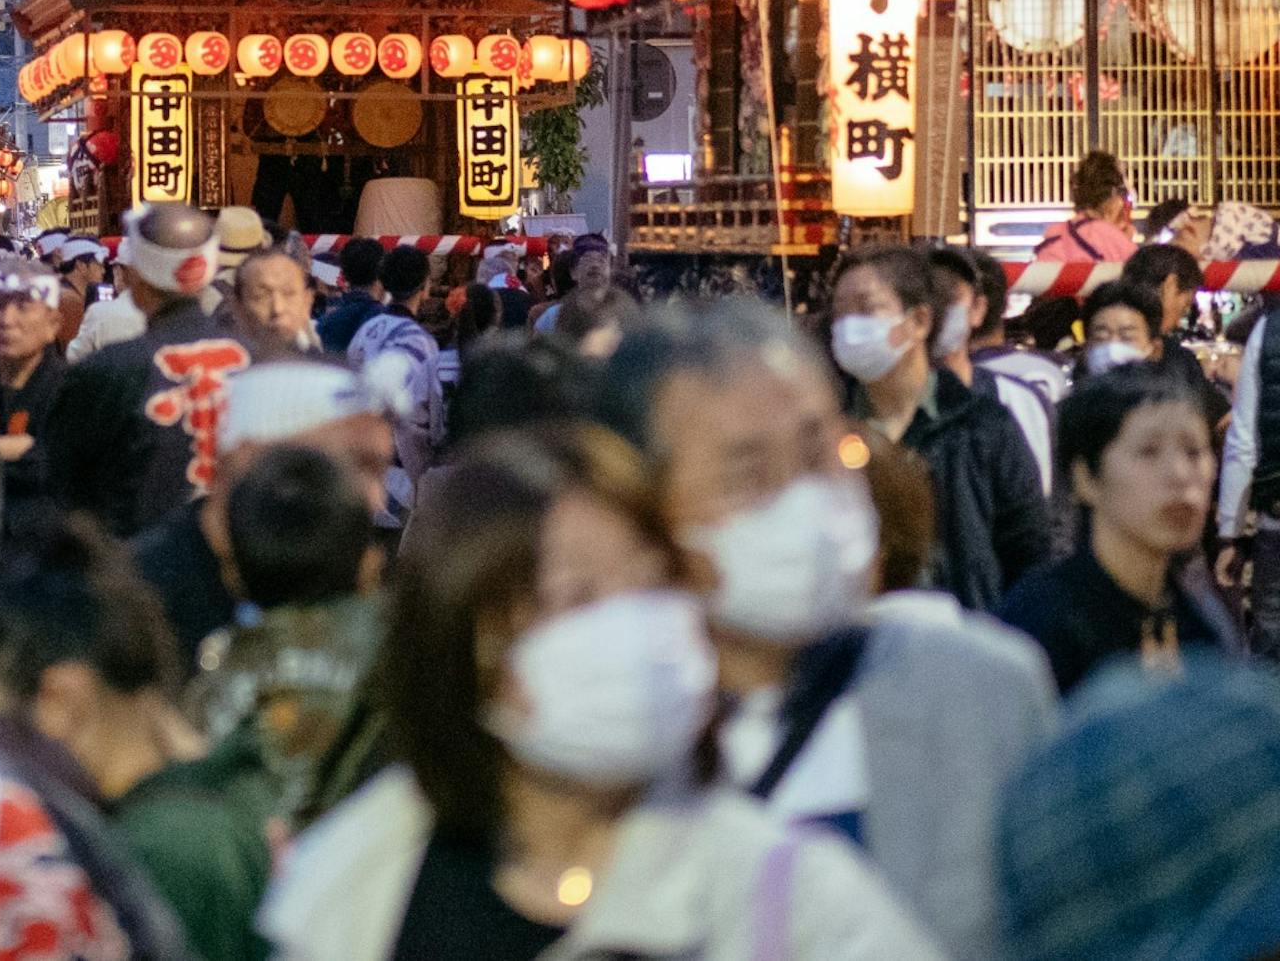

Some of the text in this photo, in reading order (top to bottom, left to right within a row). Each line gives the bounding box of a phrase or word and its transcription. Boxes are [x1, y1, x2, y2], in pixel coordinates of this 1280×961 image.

[147, 84, 184, 196] 中田町
[471, 83, 508, 196] 中田町
